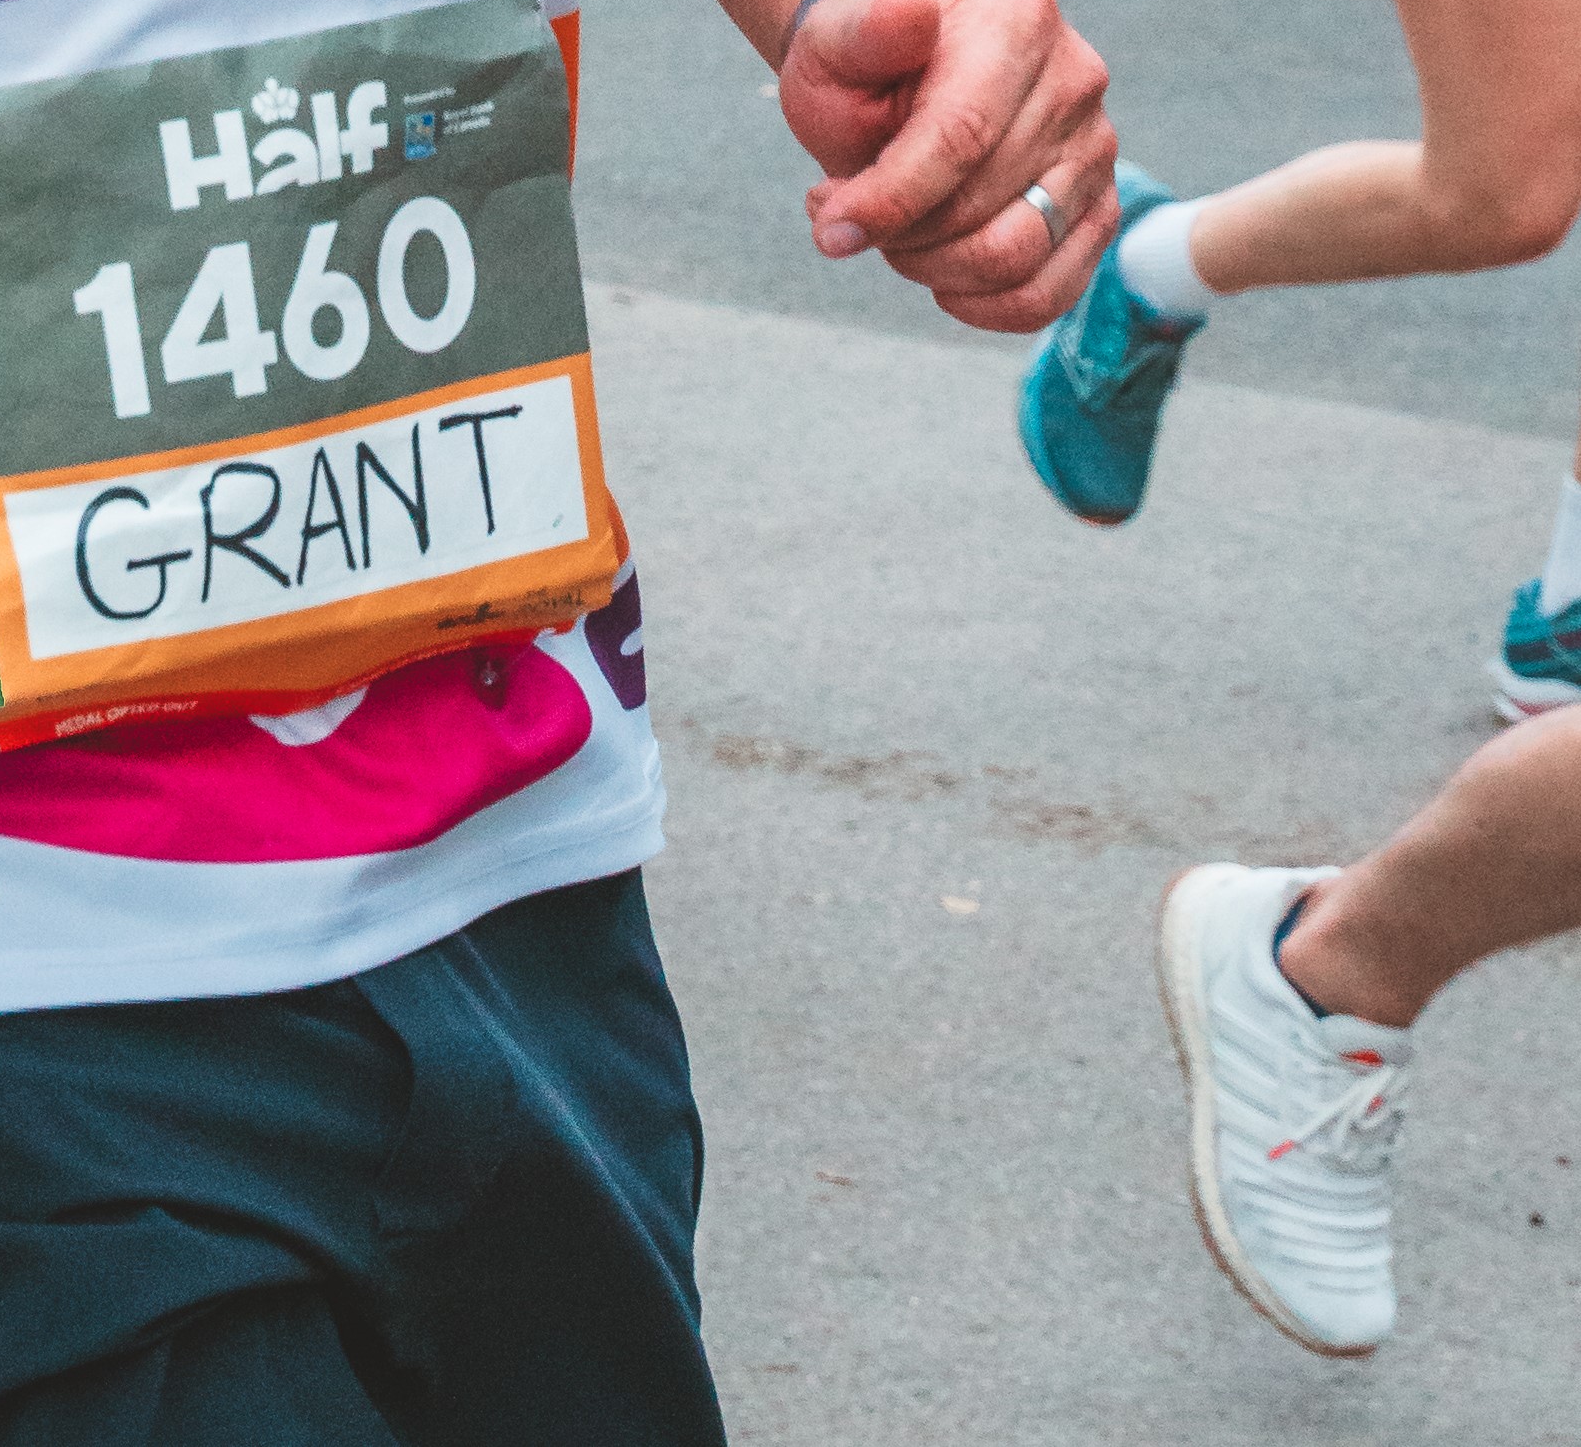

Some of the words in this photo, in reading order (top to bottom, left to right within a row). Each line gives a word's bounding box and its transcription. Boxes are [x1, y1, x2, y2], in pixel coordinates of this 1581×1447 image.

[159, 81, 389, 211] Half
[73, 197, 476, 419] 1460
[75, 405, 522, 620] GRANT
